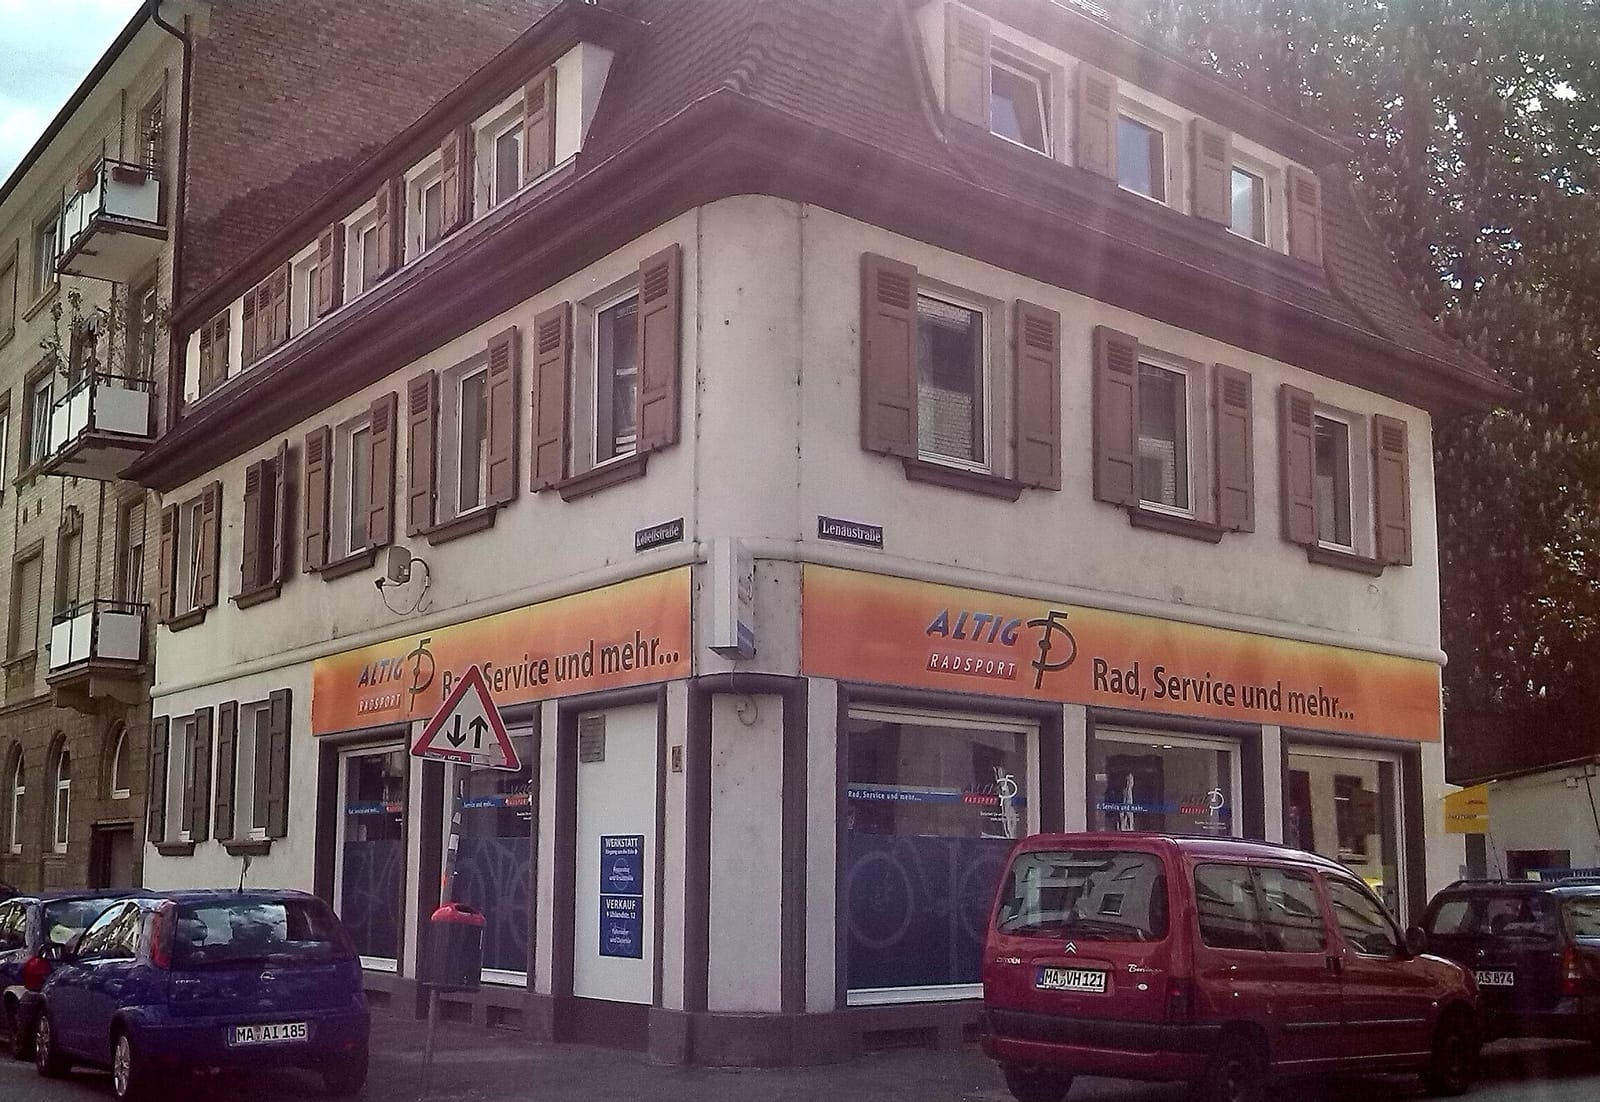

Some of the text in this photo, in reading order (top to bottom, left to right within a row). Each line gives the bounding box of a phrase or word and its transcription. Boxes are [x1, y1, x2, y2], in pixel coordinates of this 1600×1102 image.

[822, 520, 881, 543] Lenaustraße
[926, 608, 1021, 647] ALTIG
[358, 656, 405, 688] ALTIG
[483, 653, 550, 693] Service
[555, 639, 595, 682] und
[600, 629, 680, 675] mehr...
[930, 653, 1016, 676] RADSPORT
[1093, 657, 1355, 720] Rad, Service und mehr...
[358, 694, 402, 713] RADSPORT
[605, 838, 639, 848] WERKSTATT
[606, 899, 636, 910] VERKAUF
[1044, 969, 1104, 988] MA VH 121
[237, 1024, 306, 1041] MA AI 185
